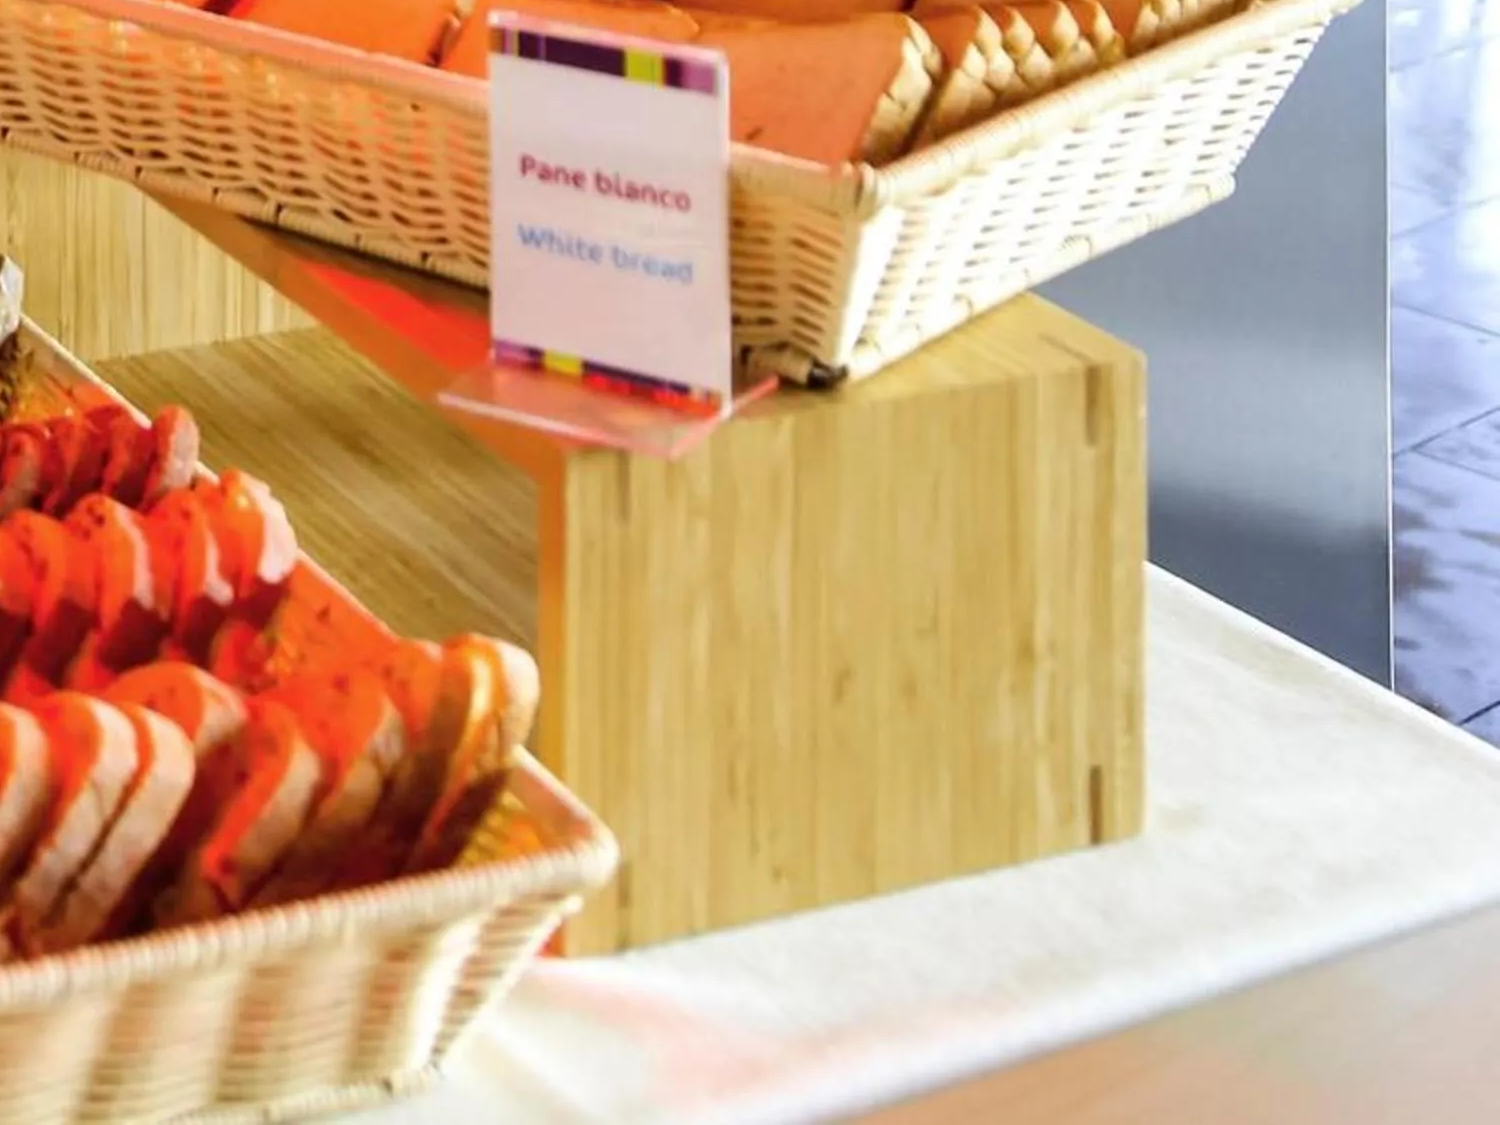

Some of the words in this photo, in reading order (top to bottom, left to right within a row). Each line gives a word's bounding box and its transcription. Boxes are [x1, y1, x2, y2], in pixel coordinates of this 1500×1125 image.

[518, 153, 587, 191] Pane
[594, 168, 693, 213] bianco
[517, 223, 603, 265] White
[612, 245, 694, 285] bread
